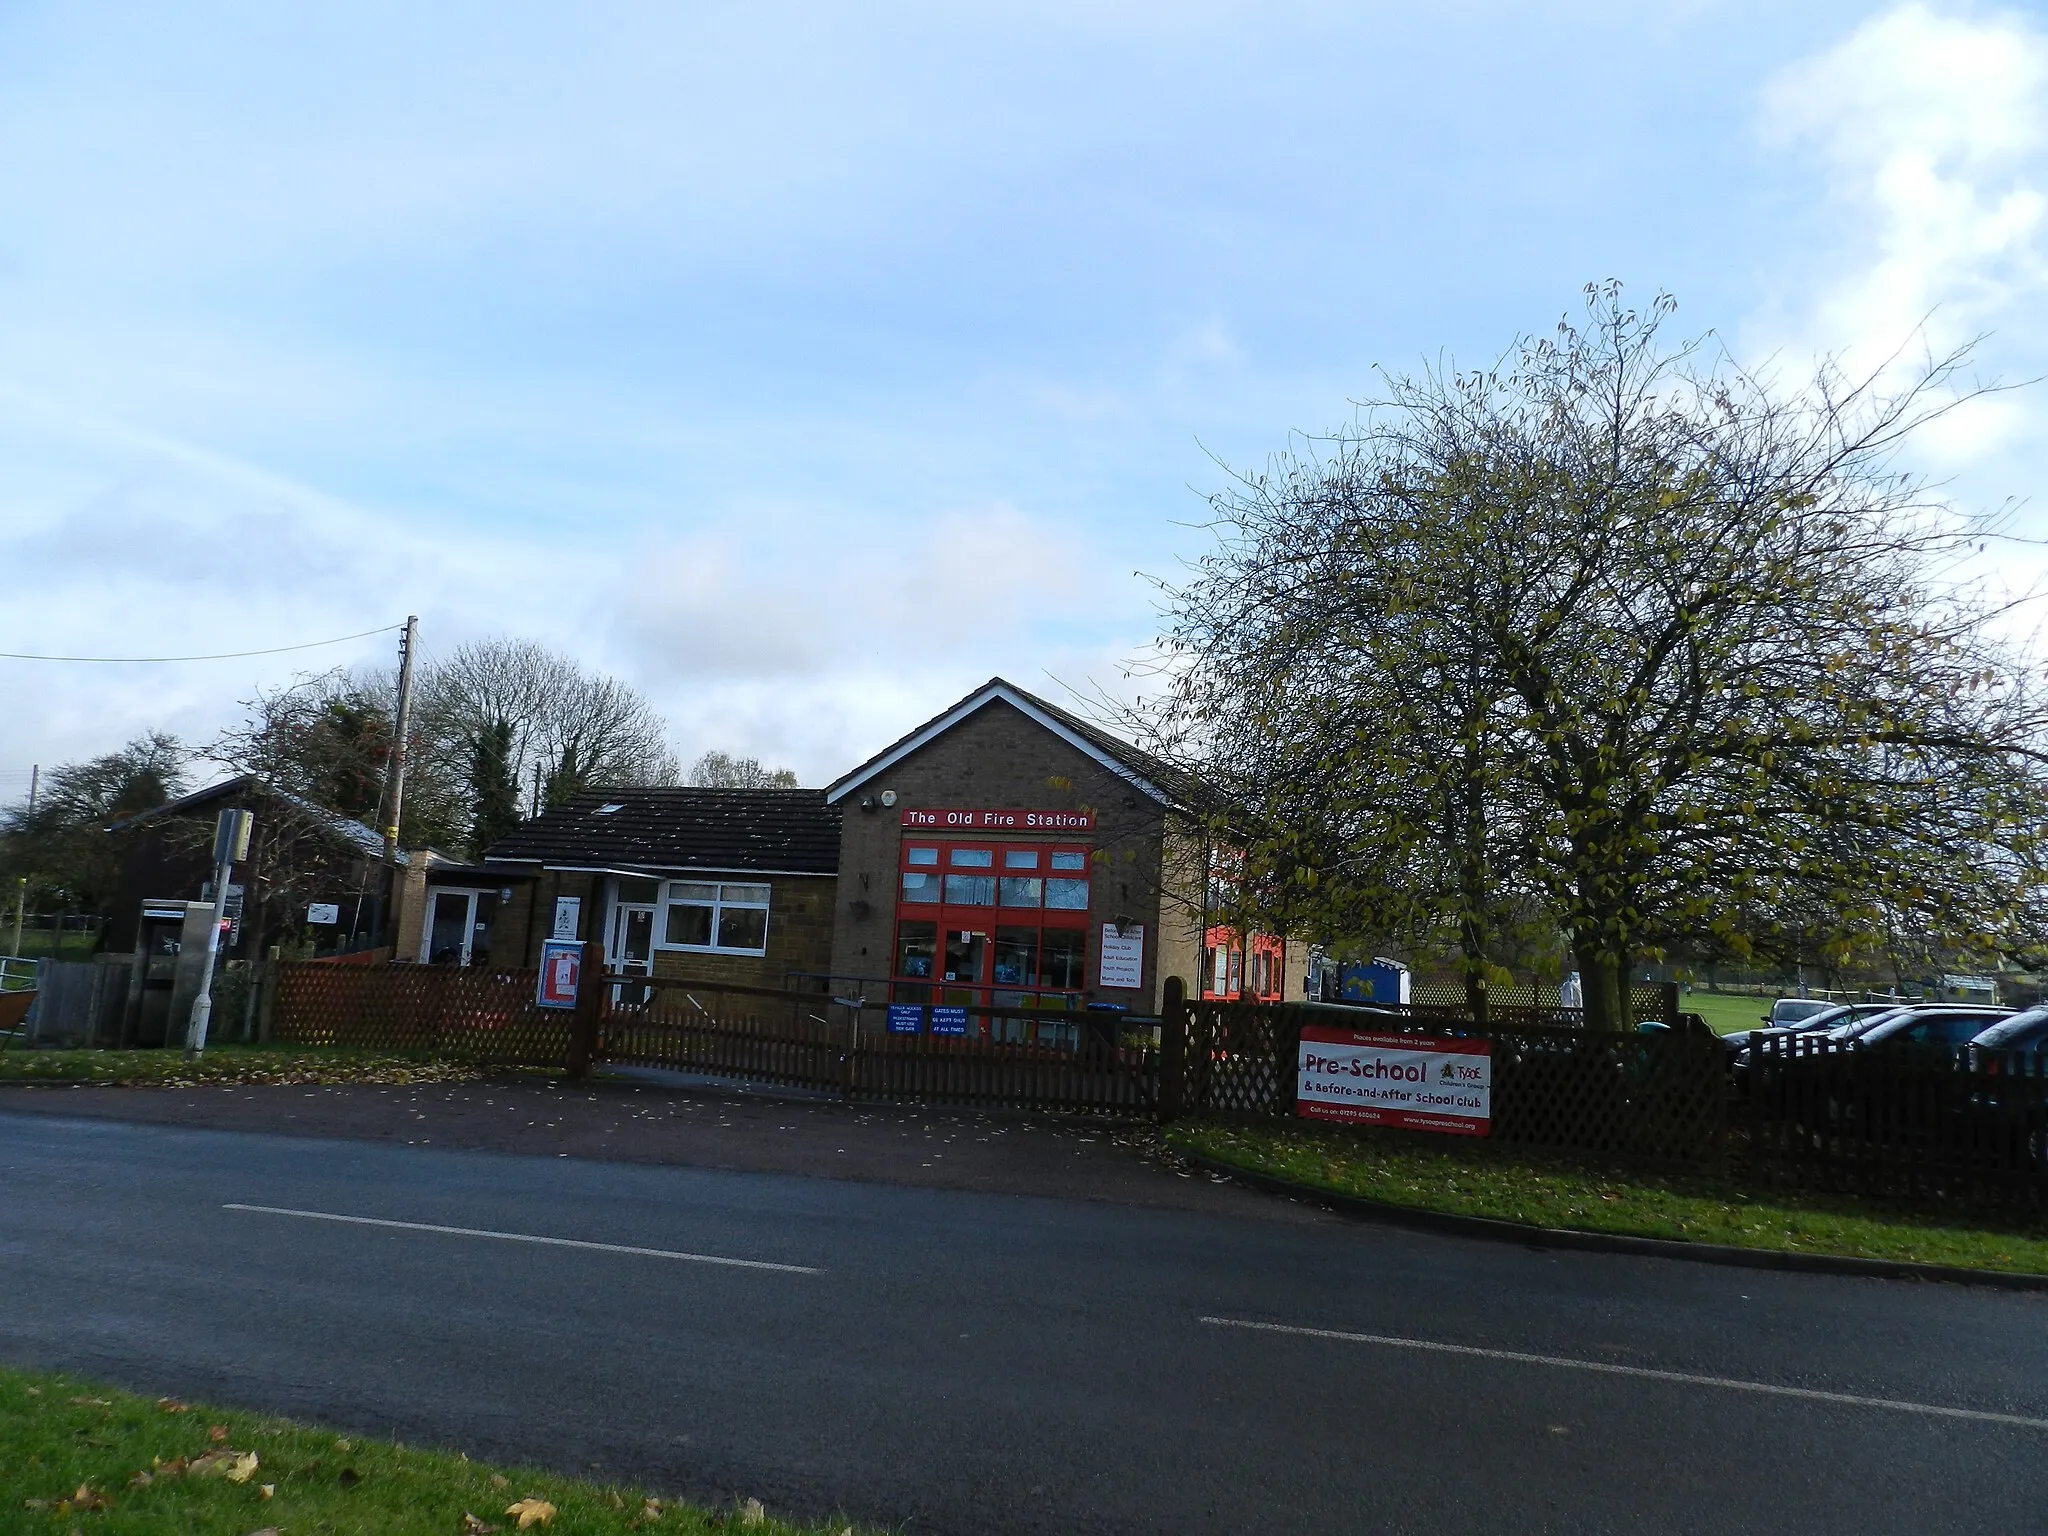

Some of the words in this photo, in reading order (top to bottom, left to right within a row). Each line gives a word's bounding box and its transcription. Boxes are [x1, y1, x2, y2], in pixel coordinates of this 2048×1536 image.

[909, 811, 936, 824] The
[947, 812, 973, 825] Old
[984, 813, 1015, 825] Fire
[1027, 813, 1088, 827] Station
[1353, 1033, 1372, 1042] Places
[1372, 1035, 1399, 1044] available
[1399, 1037, 1413, 1045] from
[1419, 1040, 1436, 1048] years
[1305, 1053, 1427, 1083] Pre-School
[1439, 1080, 1466, 1089] Children's
[1466, 1082, 1485, 1090] Group
[1304, 1080, 1313, 1091] &
[1315, 1082, 1412, 1102] Before-and-After
[1415, 1092, 1455, 1106] School
[1456, 1095, 1482, 1109] club
